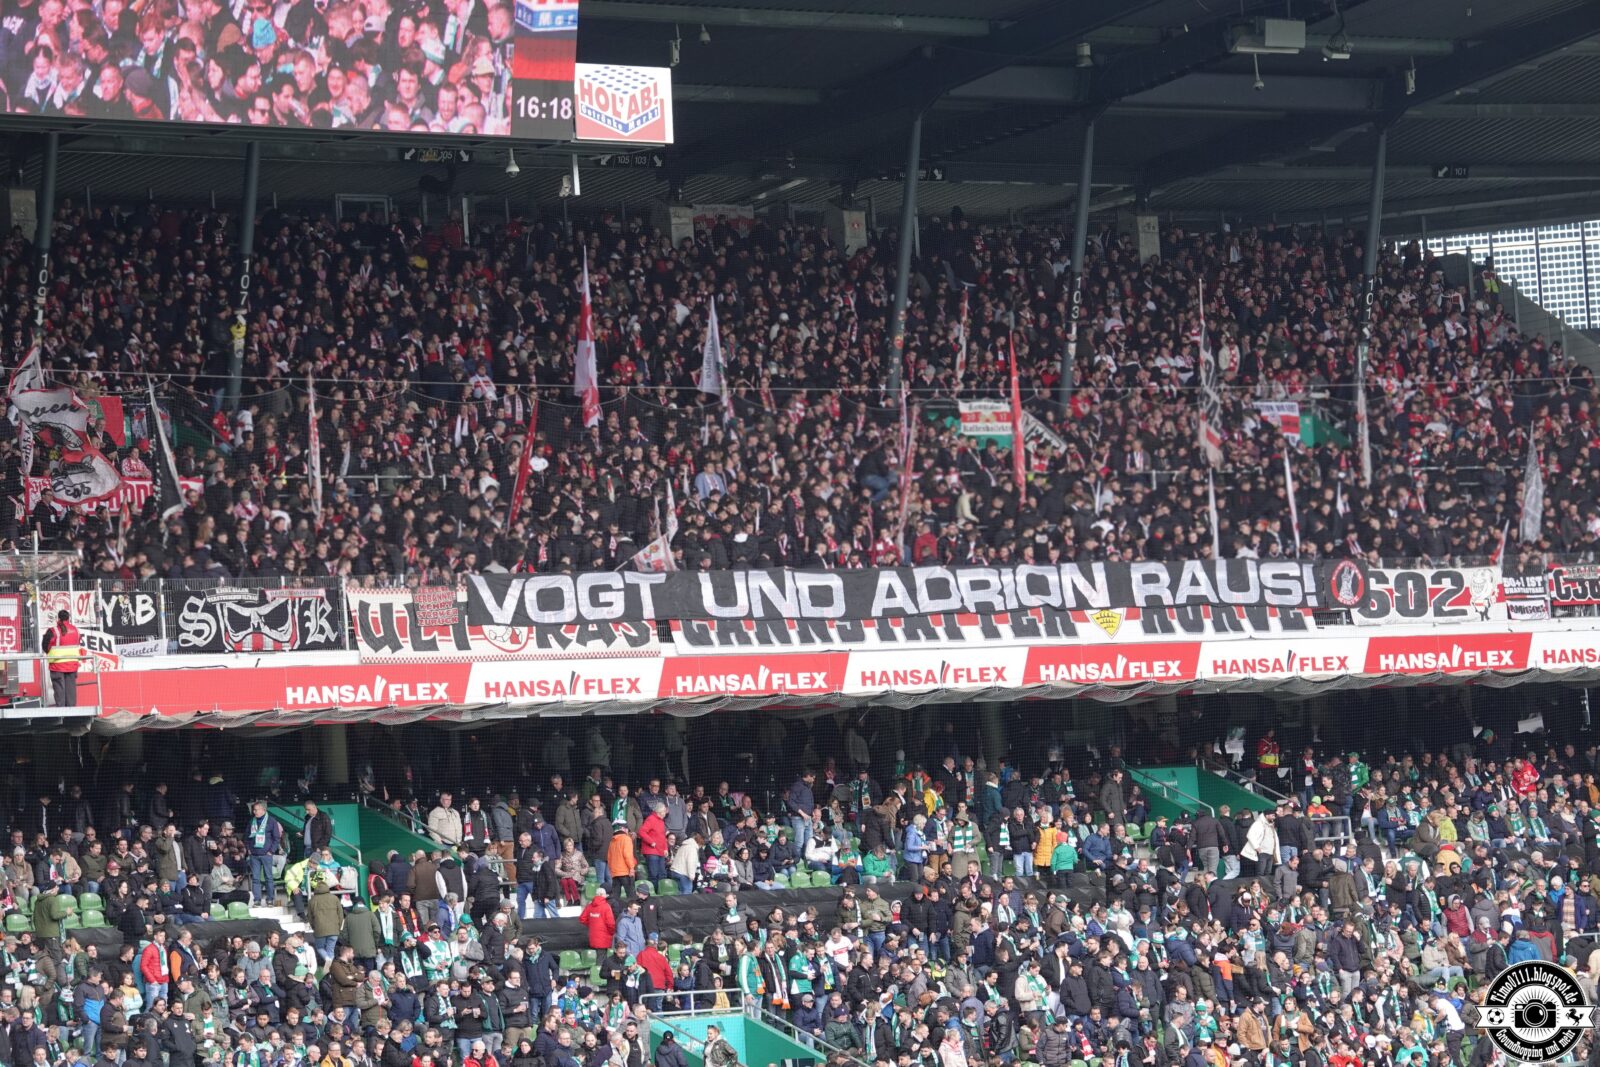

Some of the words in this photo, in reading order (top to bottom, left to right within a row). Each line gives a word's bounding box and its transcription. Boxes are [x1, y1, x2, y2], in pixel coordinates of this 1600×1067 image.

[516, 96, 573, 120] 16:18
[617, 155, 630, 164] 105
[634, 156, 647, 165] 103
[239, 258, 251, 307] 107
[1071, 276, 1083, 320] 103
[1366, 278, 1375, 321] 101
[469, 571, 667, 625] VOGT
[698, 568, 846, 619] UND
[871, 561, 1112, 617] ADRION
[1130, 558, 1319, 609] RAUS!
[1212, 657, 1286, 675] HANSA
[1300, 655, 1349, 671] FLEX
[1379, 652, 1448, 671] HANSA
[1463, 650, 1514, 667] FLEX
[1542, 648, 1600, 666] HANS
[676, 674, 757, 693] HANSA
[771, 671, 828, 690] FLEX
[860, 669, 938, 687] HANSA
[953, 666, 1008, 684] FLEX
[1039, 664, 1113, 682] HANSA
[1128, 660, 1182, 678] FLEX
[286, 684, 370, 705] HANSA
[389, 682, 449, 702] FLEX
[484, 680, 567, 699] HANSA
[583, 677, 642, 695] FLEX
